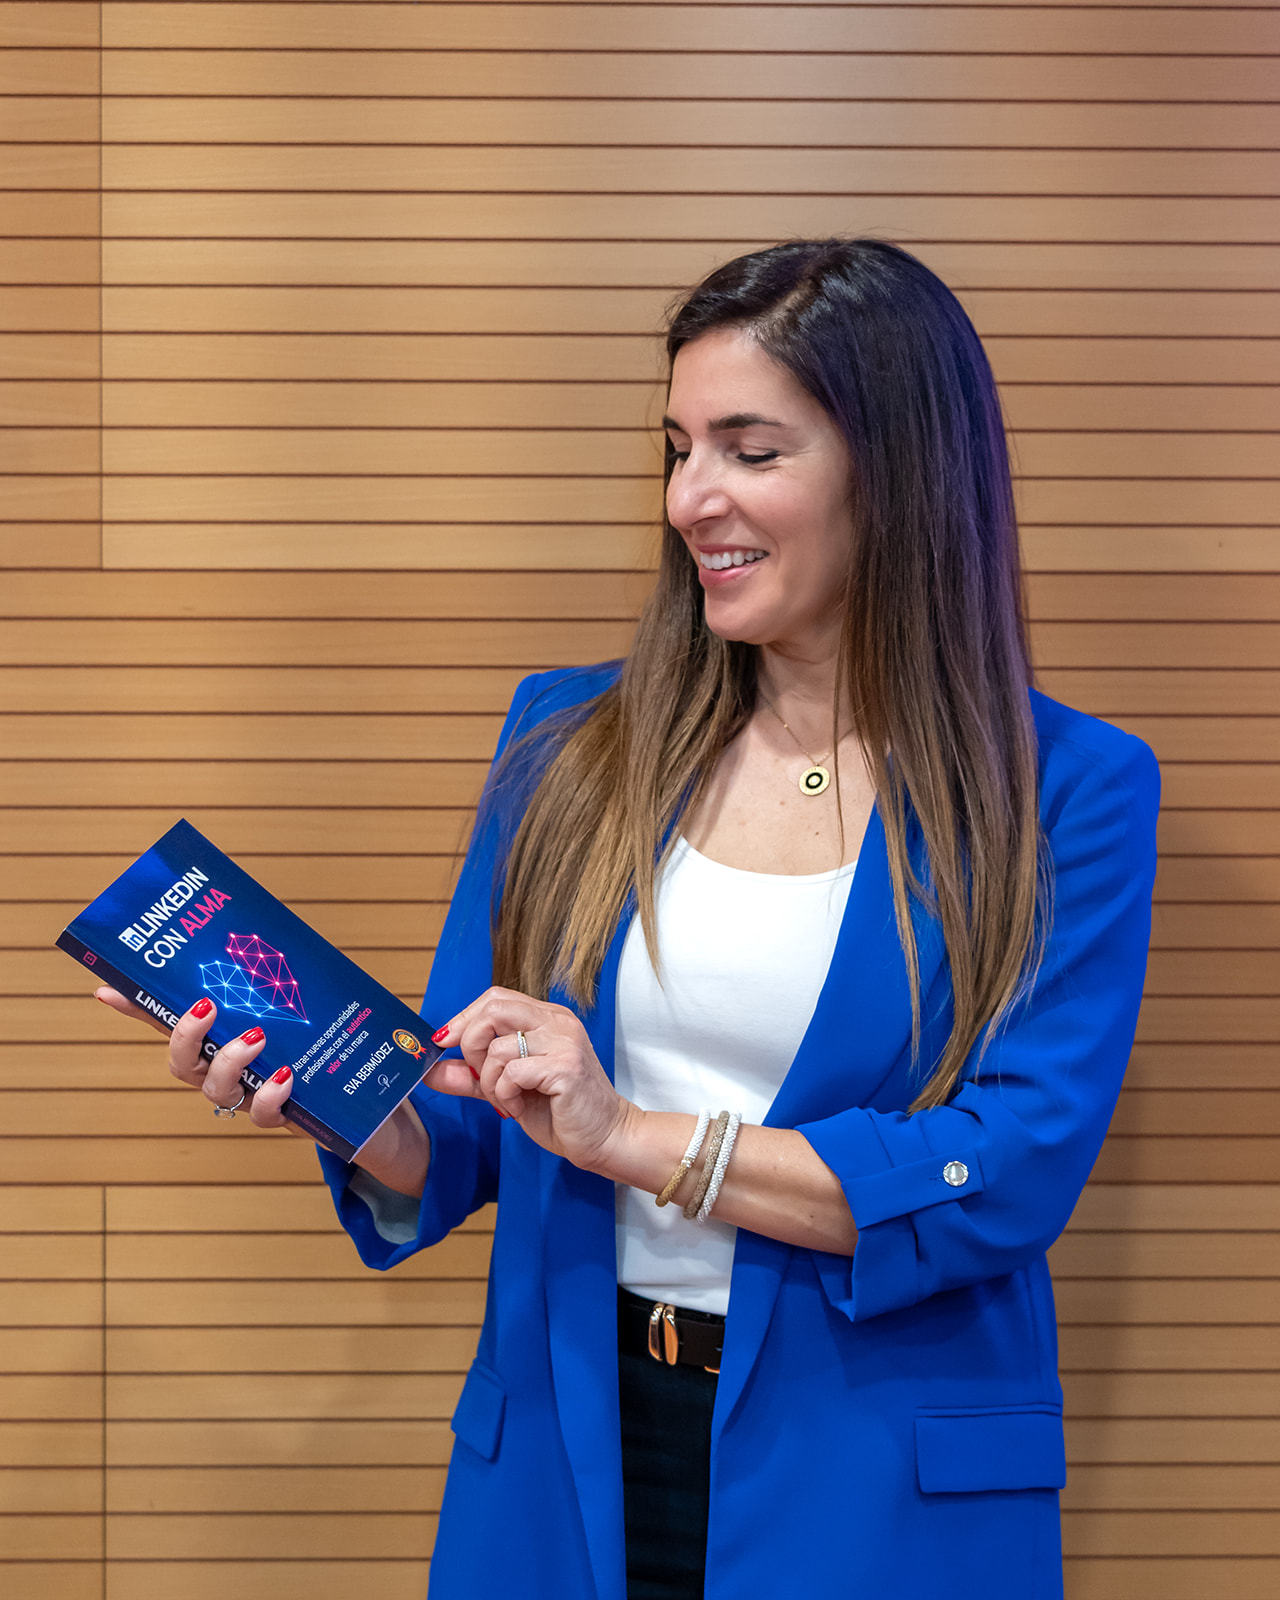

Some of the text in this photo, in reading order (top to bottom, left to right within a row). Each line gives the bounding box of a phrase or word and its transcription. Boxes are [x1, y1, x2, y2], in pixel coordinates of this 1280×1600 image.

[132, 866, 209, 938] LINKEDIN
[144, 888, 232, 968] CON ALMA
[291, 1000, 360, 1072] Atrae nuevas oportunidades
[301, 1007, 372, 1084] profesionales con el auténtico
[326, 1030, 370, 1075] valor de tu marca
[342, 1078, 363, 1095] EVA
[355, 1041, 394, 1081] BERMÚDEZ
